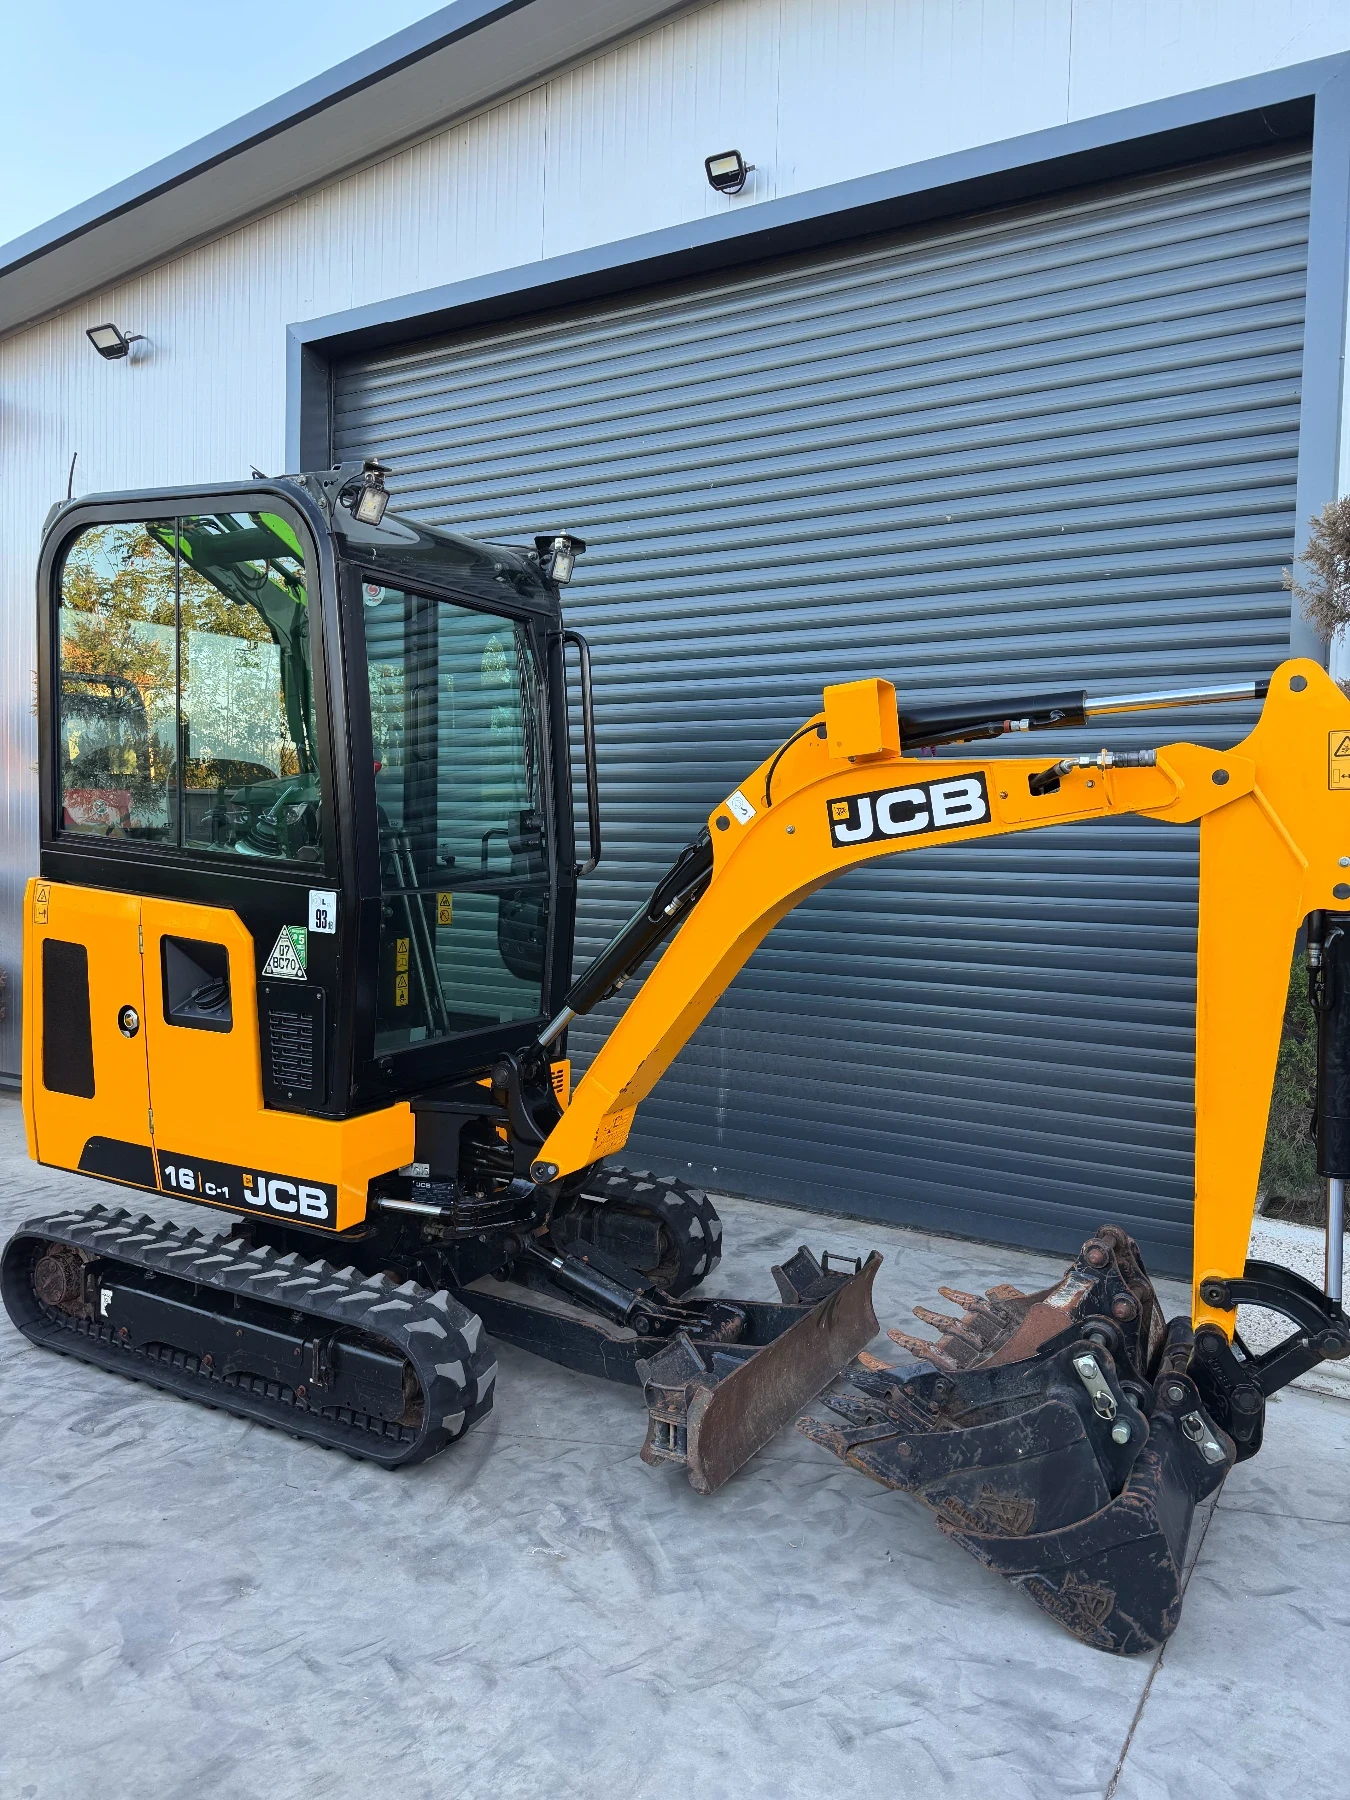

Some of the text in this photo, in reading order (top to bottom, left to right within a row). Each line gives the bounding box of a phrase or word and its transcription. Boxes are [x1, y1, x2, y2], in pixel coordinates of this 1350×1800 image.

[834, 778, 987, 842] JCB
[316, 908, 328, 929] 93
[272, 957, 297, 970] BC70
[164, 1166, 195, 1191] 16
[243, 1176, 329, 1220] JCB
